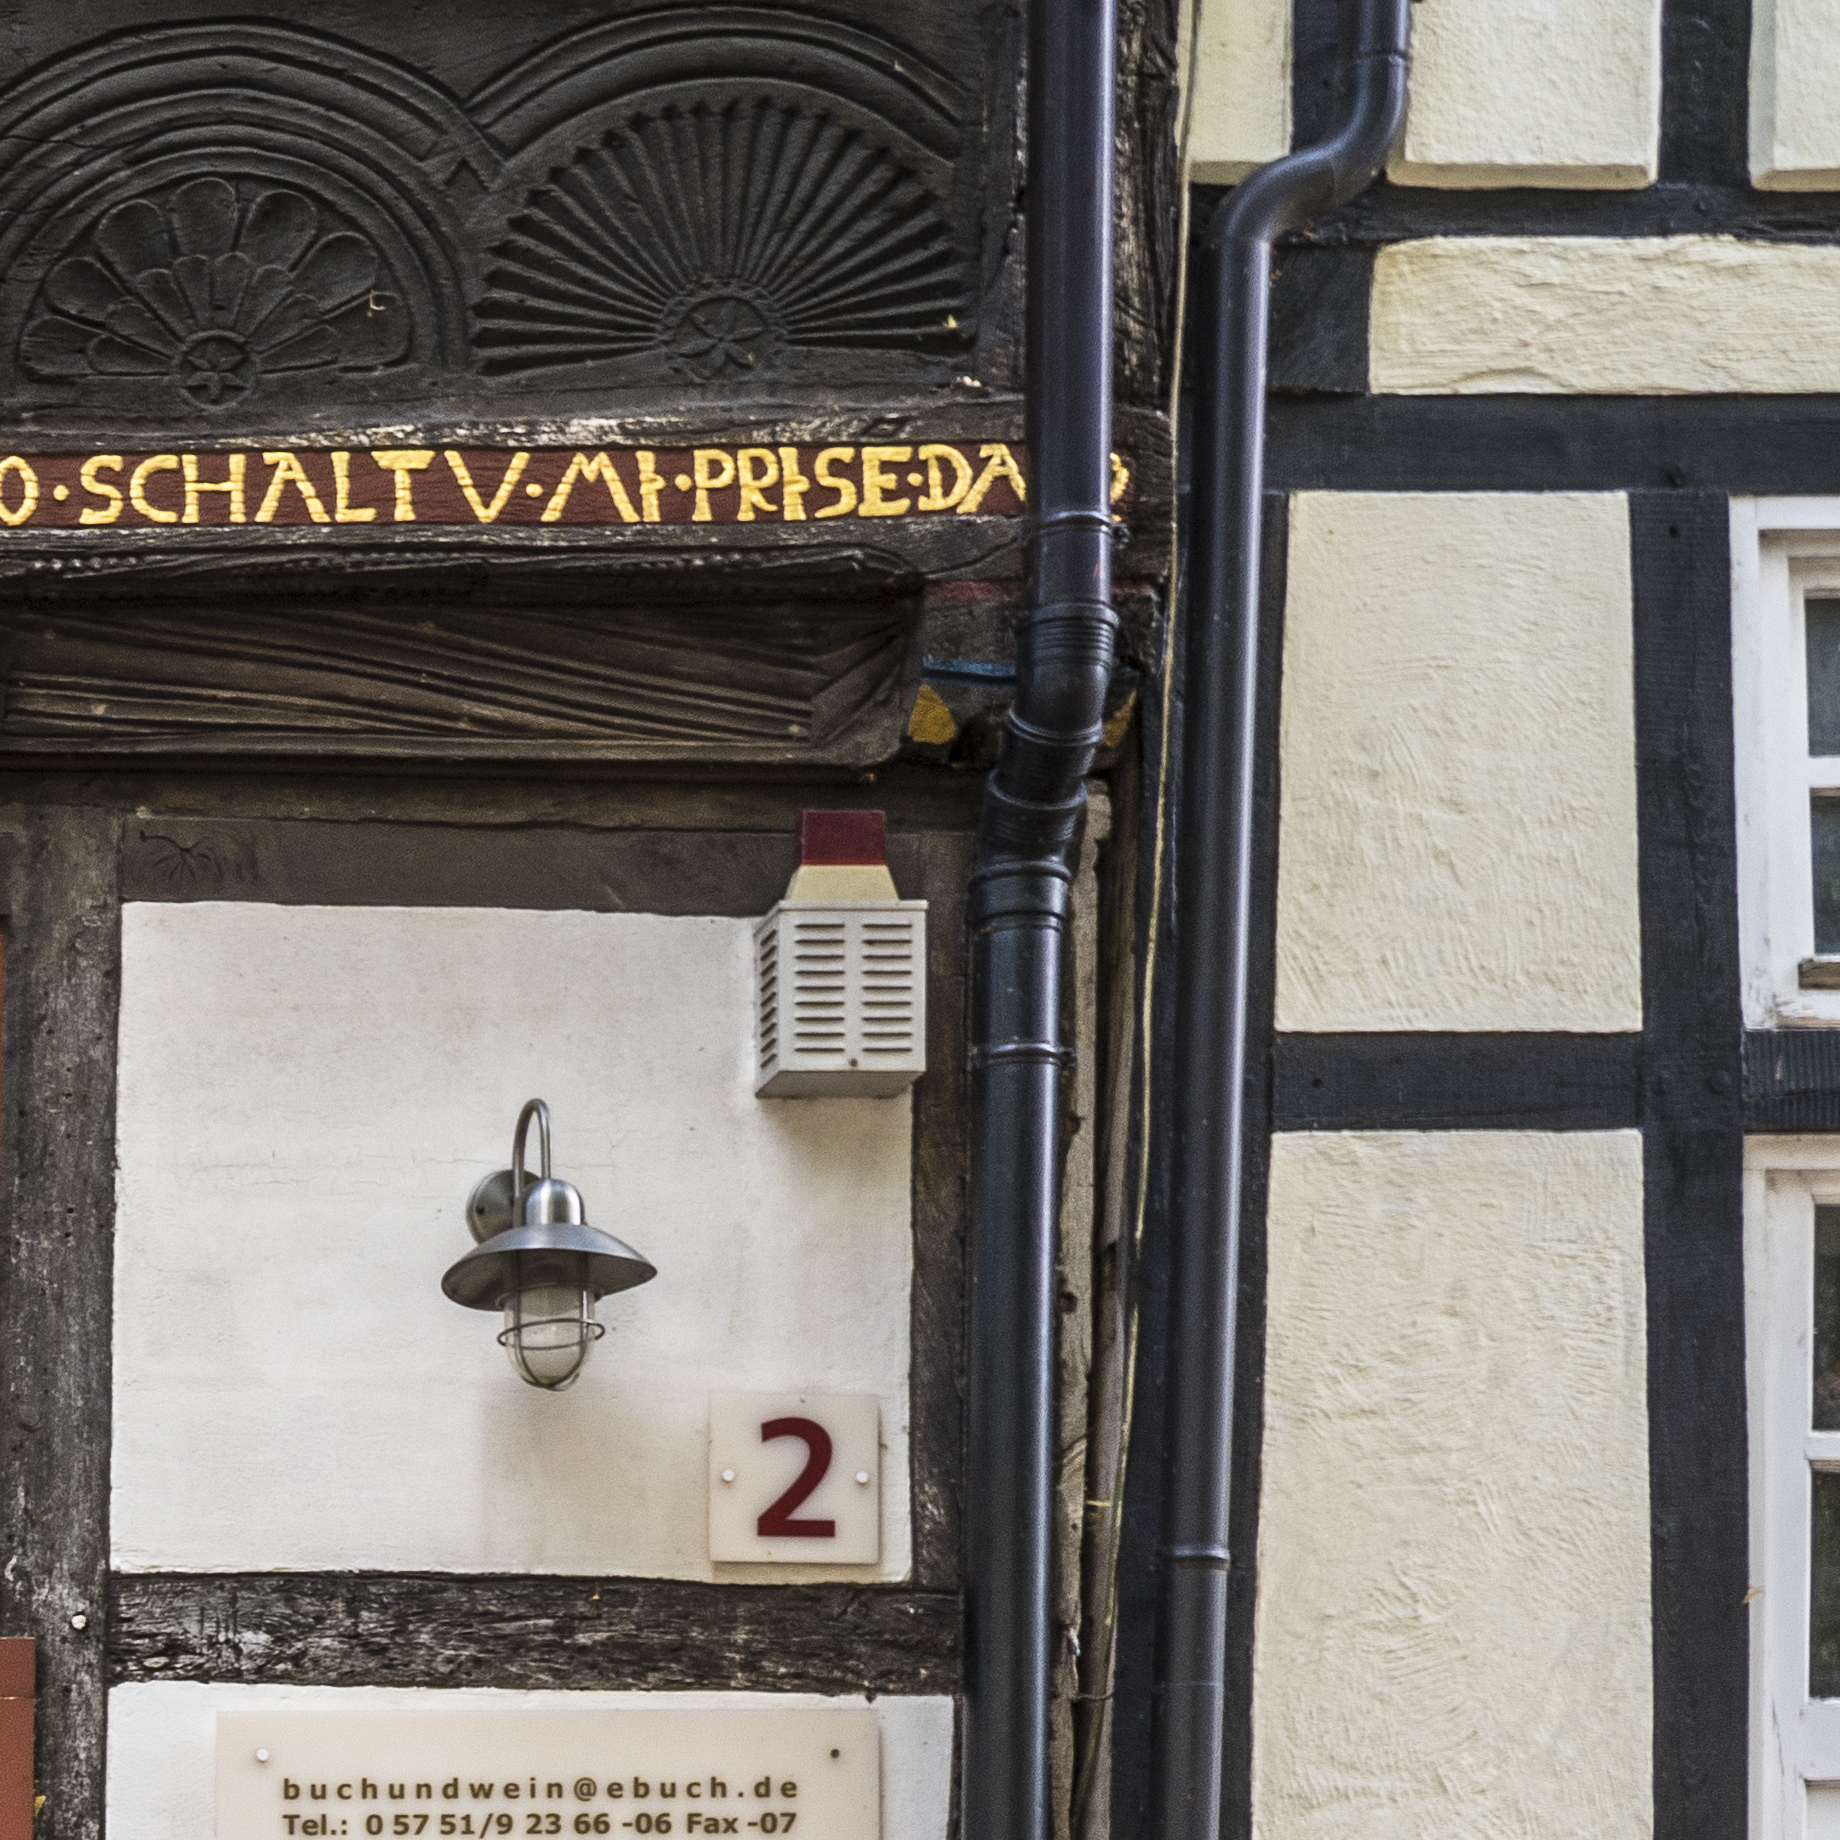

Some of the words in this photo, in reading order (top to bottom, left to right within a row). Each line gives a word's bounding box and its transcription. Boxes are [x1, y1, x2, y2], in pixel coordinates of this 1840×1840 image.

[757, 1417, 835, 1538] 2
[282, 1776, 798, 1802] buchundwein@ebuch.de
[282, 1813, 348, 1836] Tel.:
[622, 1813, 673, 1836] -06
[687, 1813, 739, 1836] Fax
[747, 1812, 797, 1835] -07
